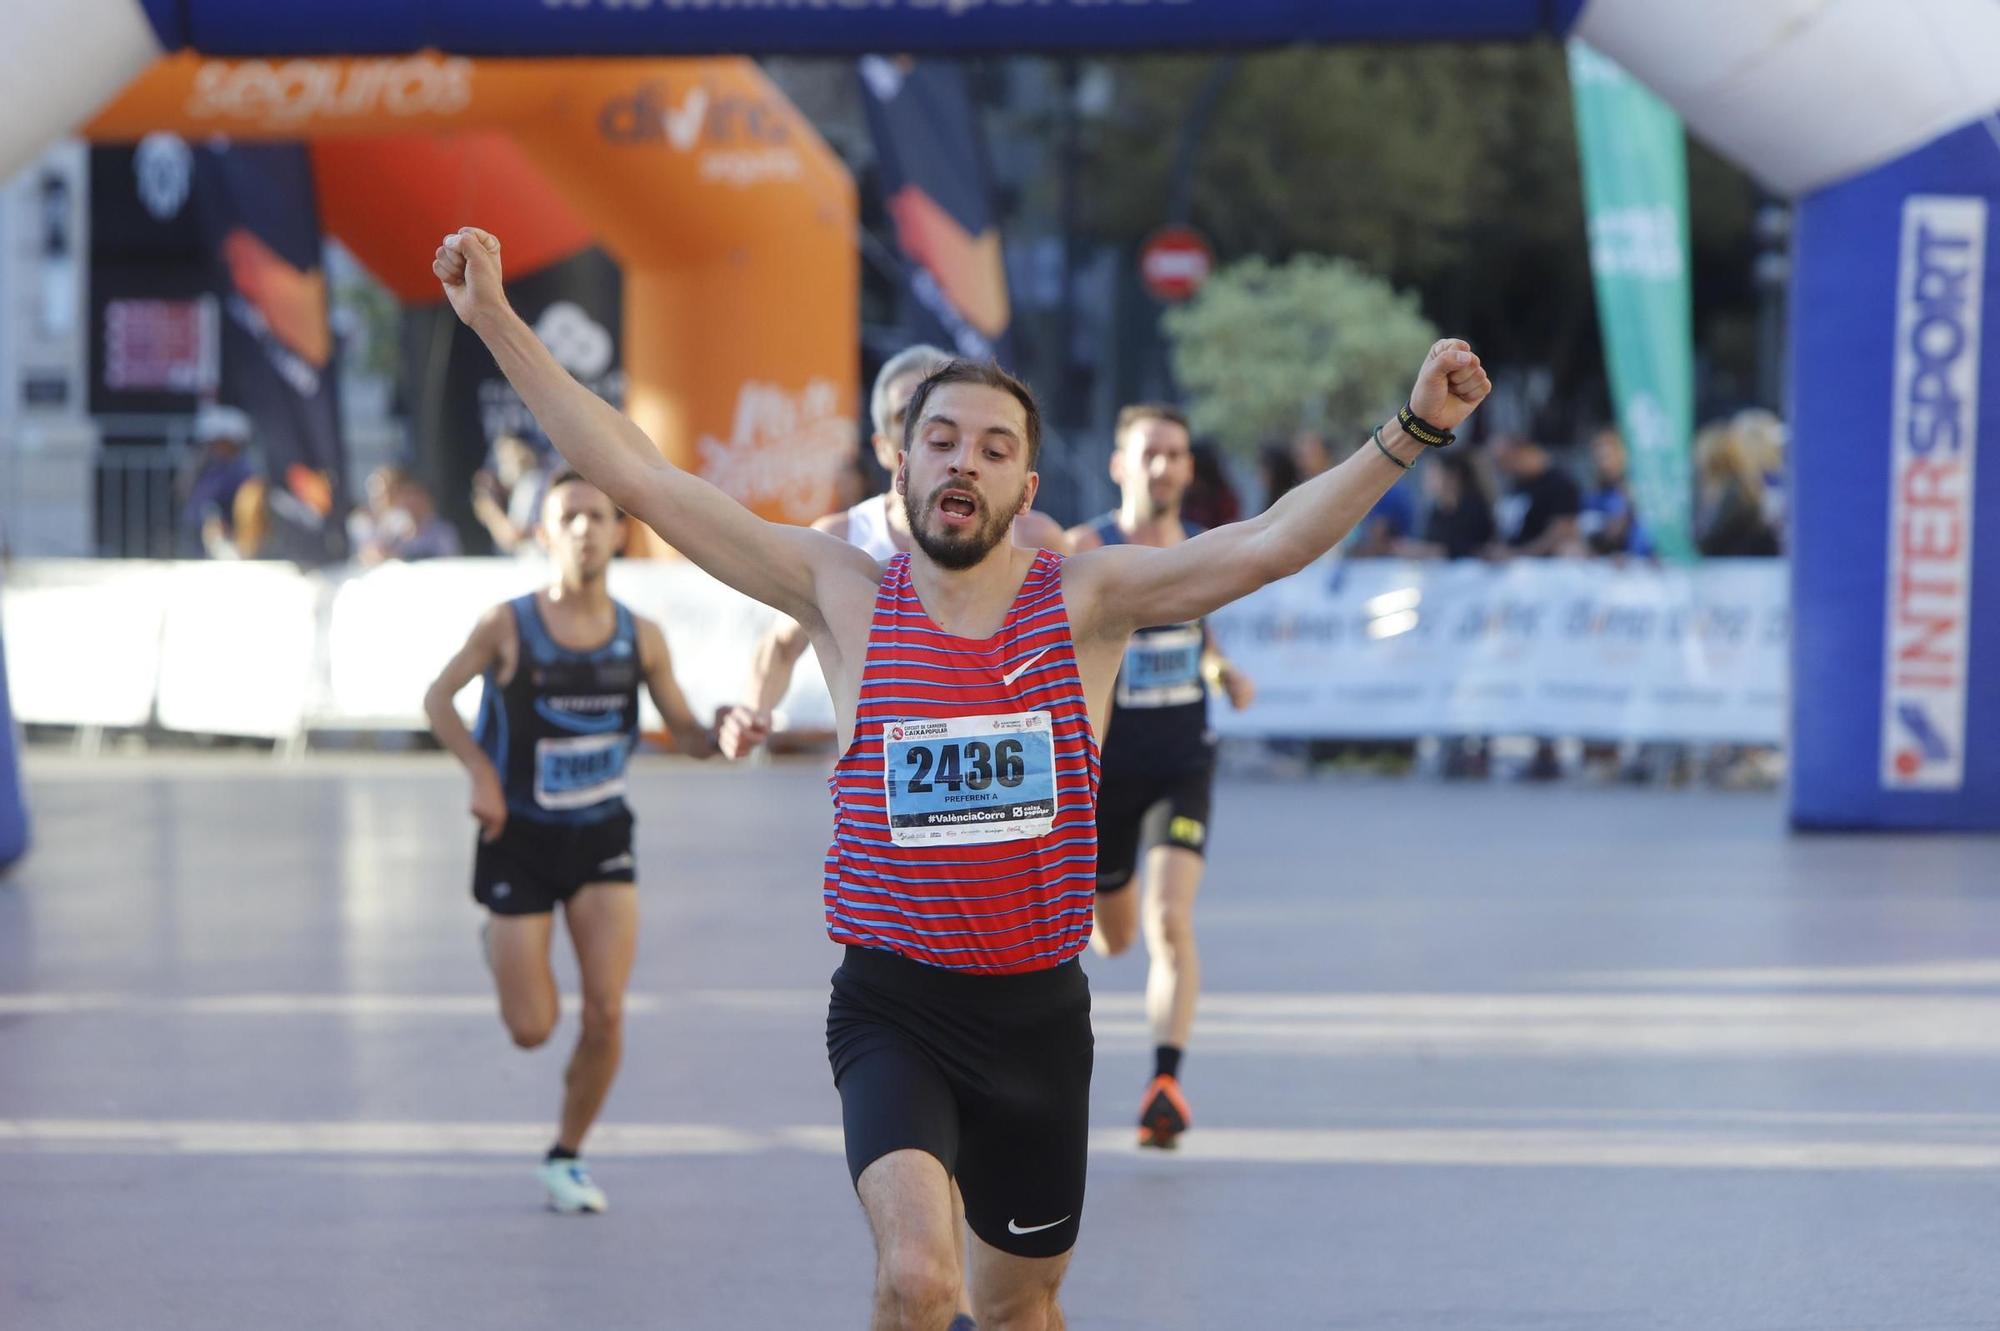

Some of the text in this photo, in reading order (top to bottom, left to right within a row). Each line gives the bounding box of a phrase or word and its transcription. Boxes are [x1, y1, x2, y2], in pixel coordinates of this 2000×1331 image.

[1896, 219, 1974, 689] INTERSPORT
[906, 738, 1025, 794] 2436
[944, 793, 990, 803] PREFERENT
[928, 810, 1006, 824] #ValènciaCorre
